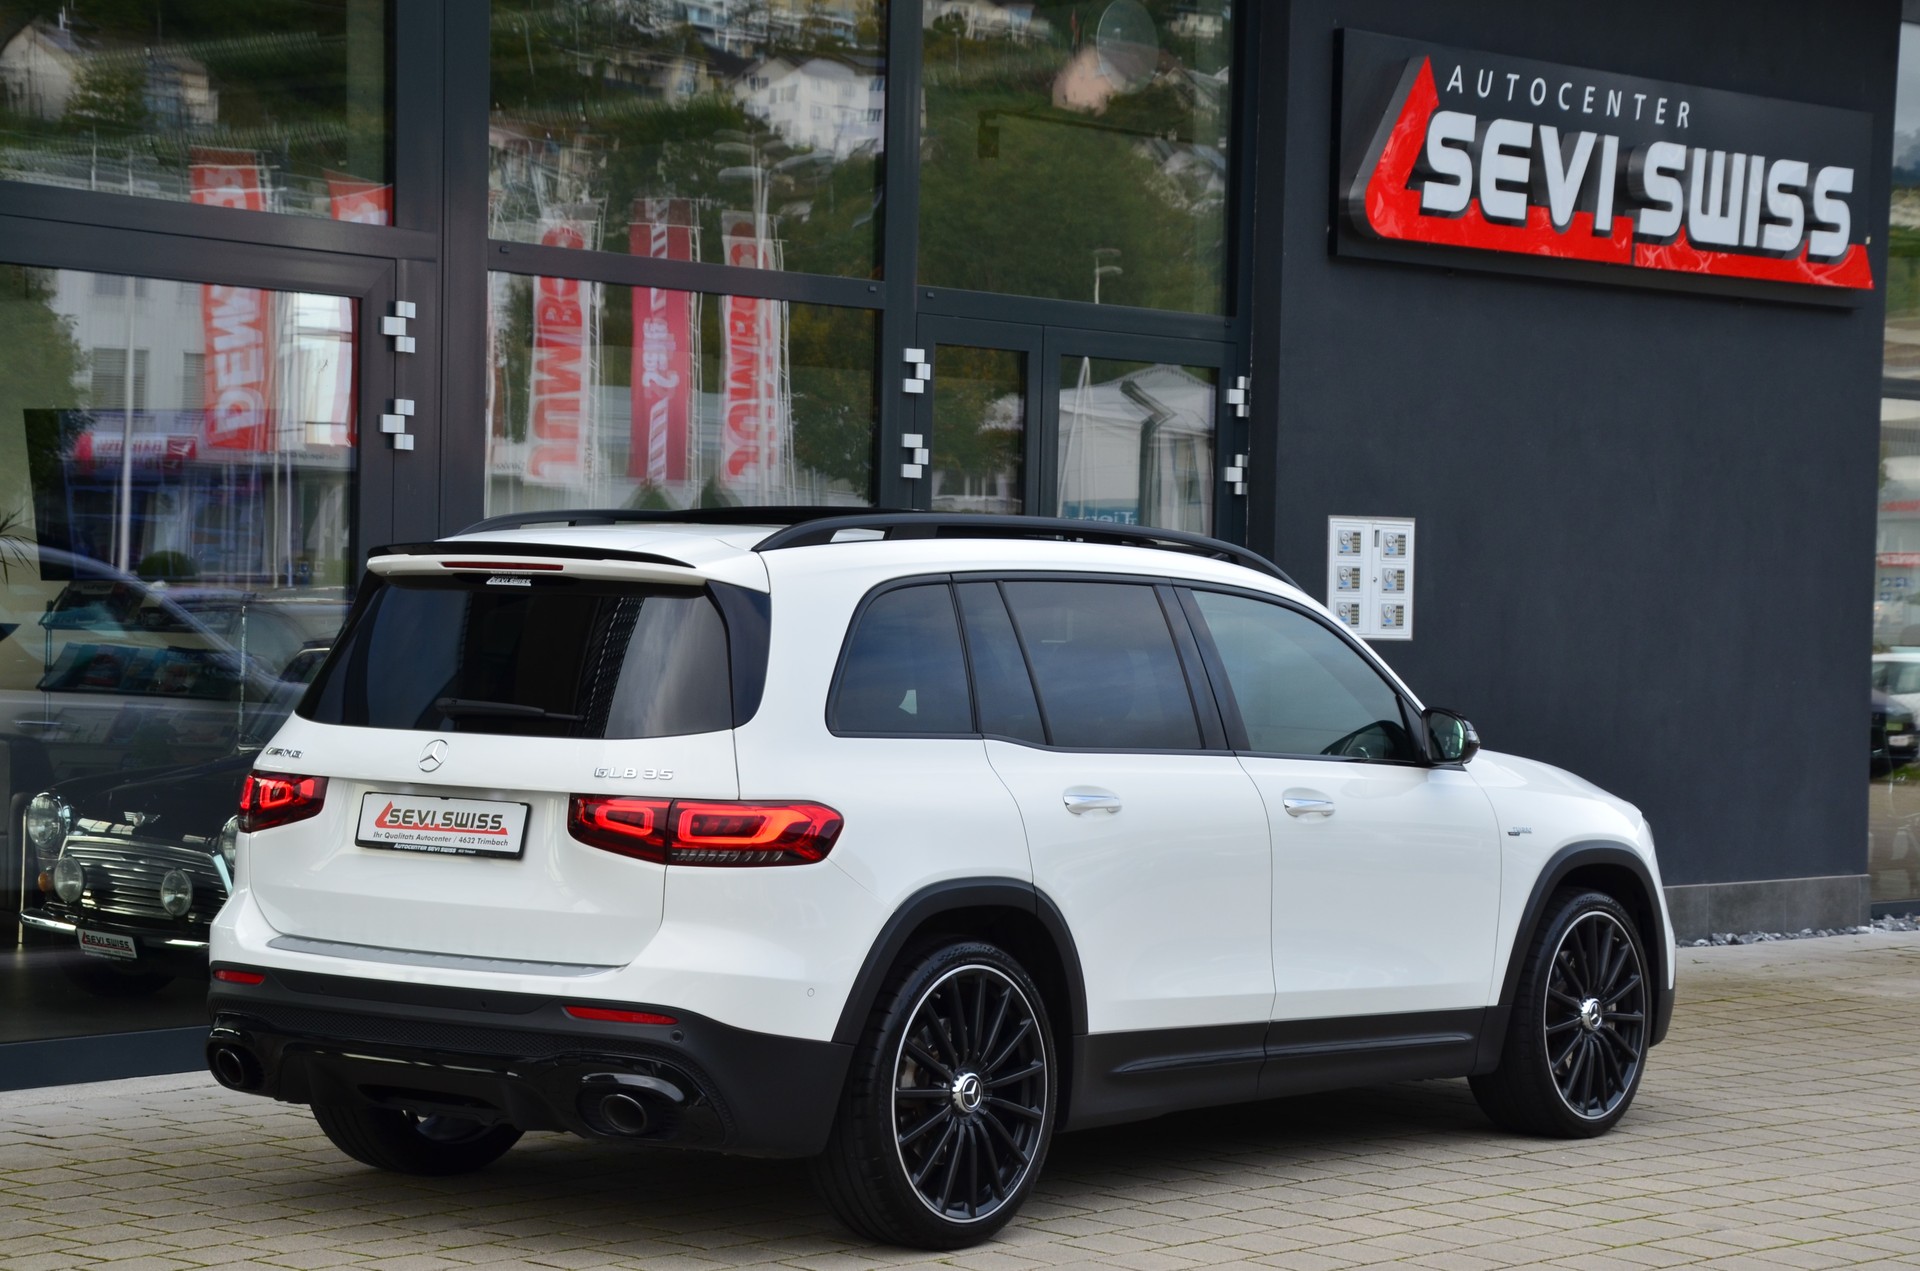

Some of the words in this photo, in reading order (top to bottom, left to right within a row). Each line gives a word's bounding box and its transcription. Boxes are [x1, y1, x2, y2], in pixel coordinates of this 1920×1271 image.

[1446, 64, 1690, 128] AUTOCENTER
[1419, 109, 1619, 231] SEVI
[1636, 140, 1854, 258] SWISS
[268, 747, 303, 758] AMG
[594, 767, 637, 779] GLB
[643, 768, 674, 780] 35
[388, 808, 437, 827] SEVI
[441, 811, 503, 830] SWISS
[373, 831, 382, 839] Ihr
[416, 833, 452, 843] Autocenter
[458, 837, 475, 845] 4632
[477, 837, 509, 847] Trimbach
[86, 935, 104, 945] SEVI
[105, 938, 129, 948] SWISS
